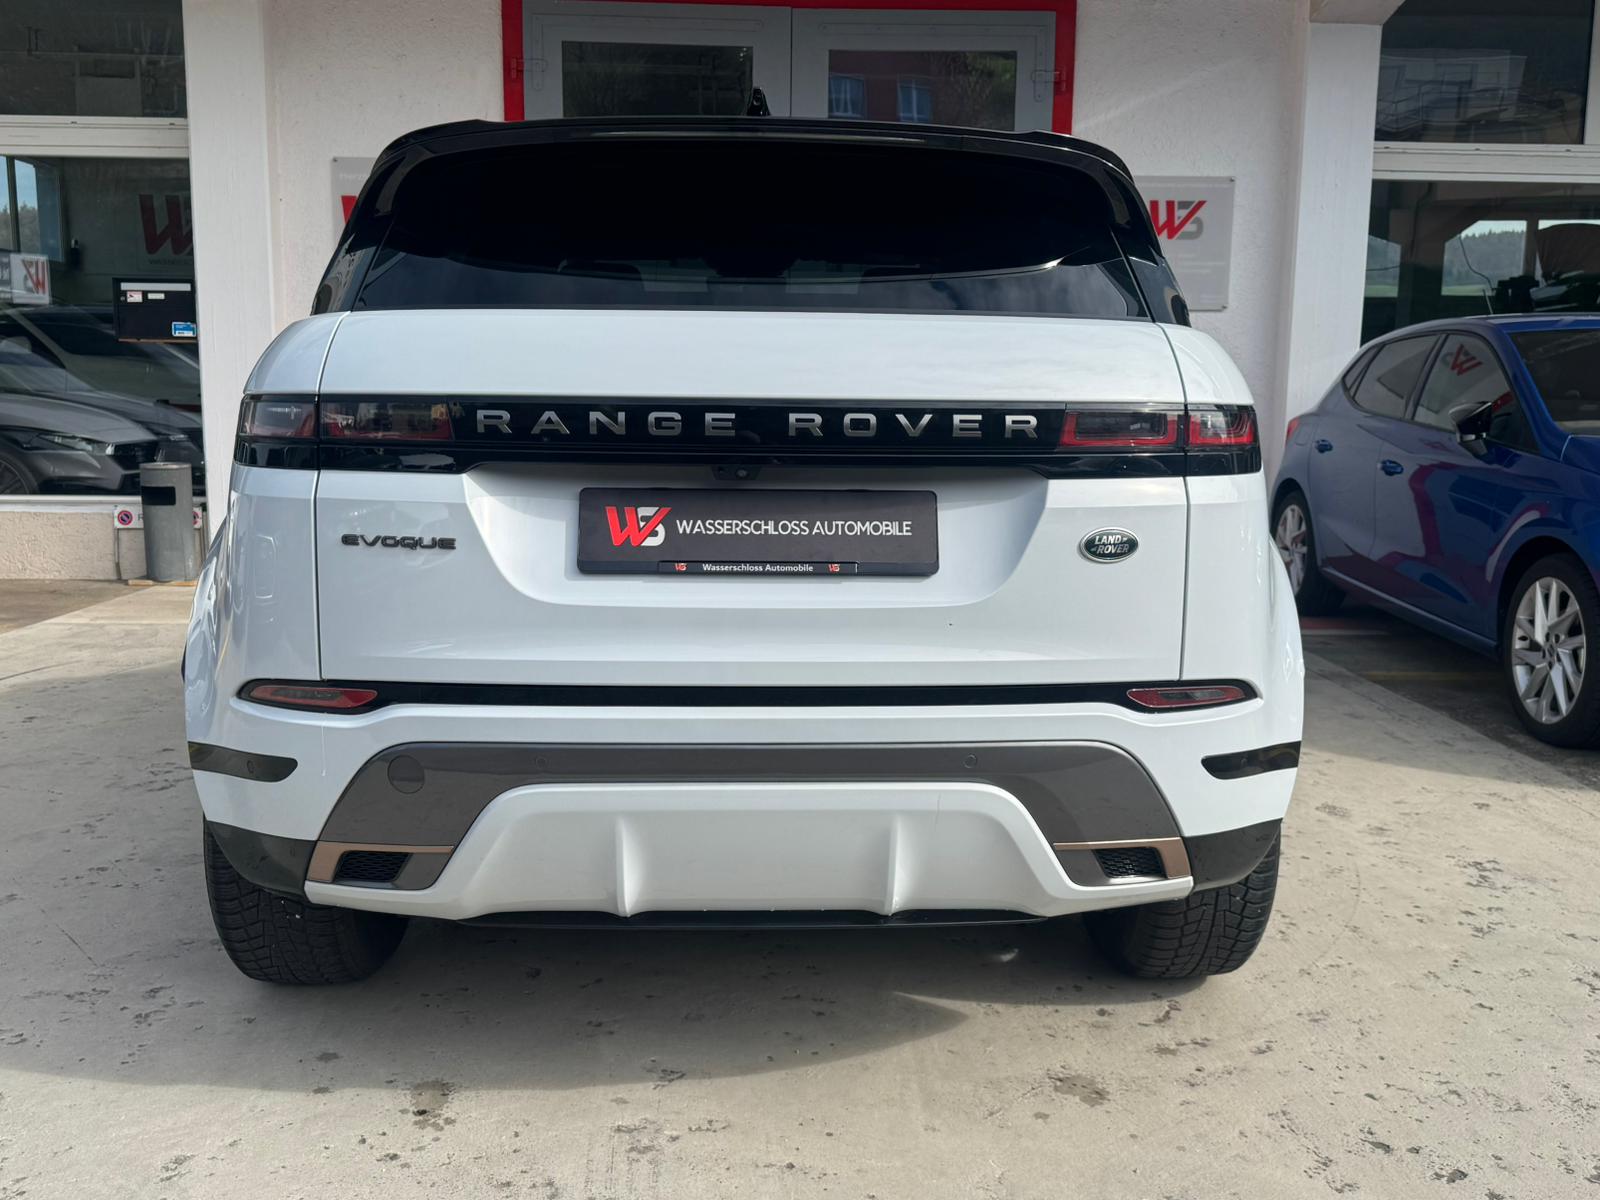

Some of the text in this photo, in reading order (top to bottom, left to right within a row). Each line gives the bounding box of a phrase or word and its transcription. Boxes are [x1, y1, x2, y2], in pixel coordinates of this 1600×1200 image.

[476, 409, 1038, 438] RANGE ROVER
[676, 519, 913, 536] WASSERSCHLOSS AUTOMOBILE
[341, 533, 457, 550] EVOQUE
[1094, 534, 1122, 545] LAND
[1096, 543, 1130, 554] ROVER
[702, 563, 764, 572] Wasserschloss
[765, 563, 814, 573] Automobile
